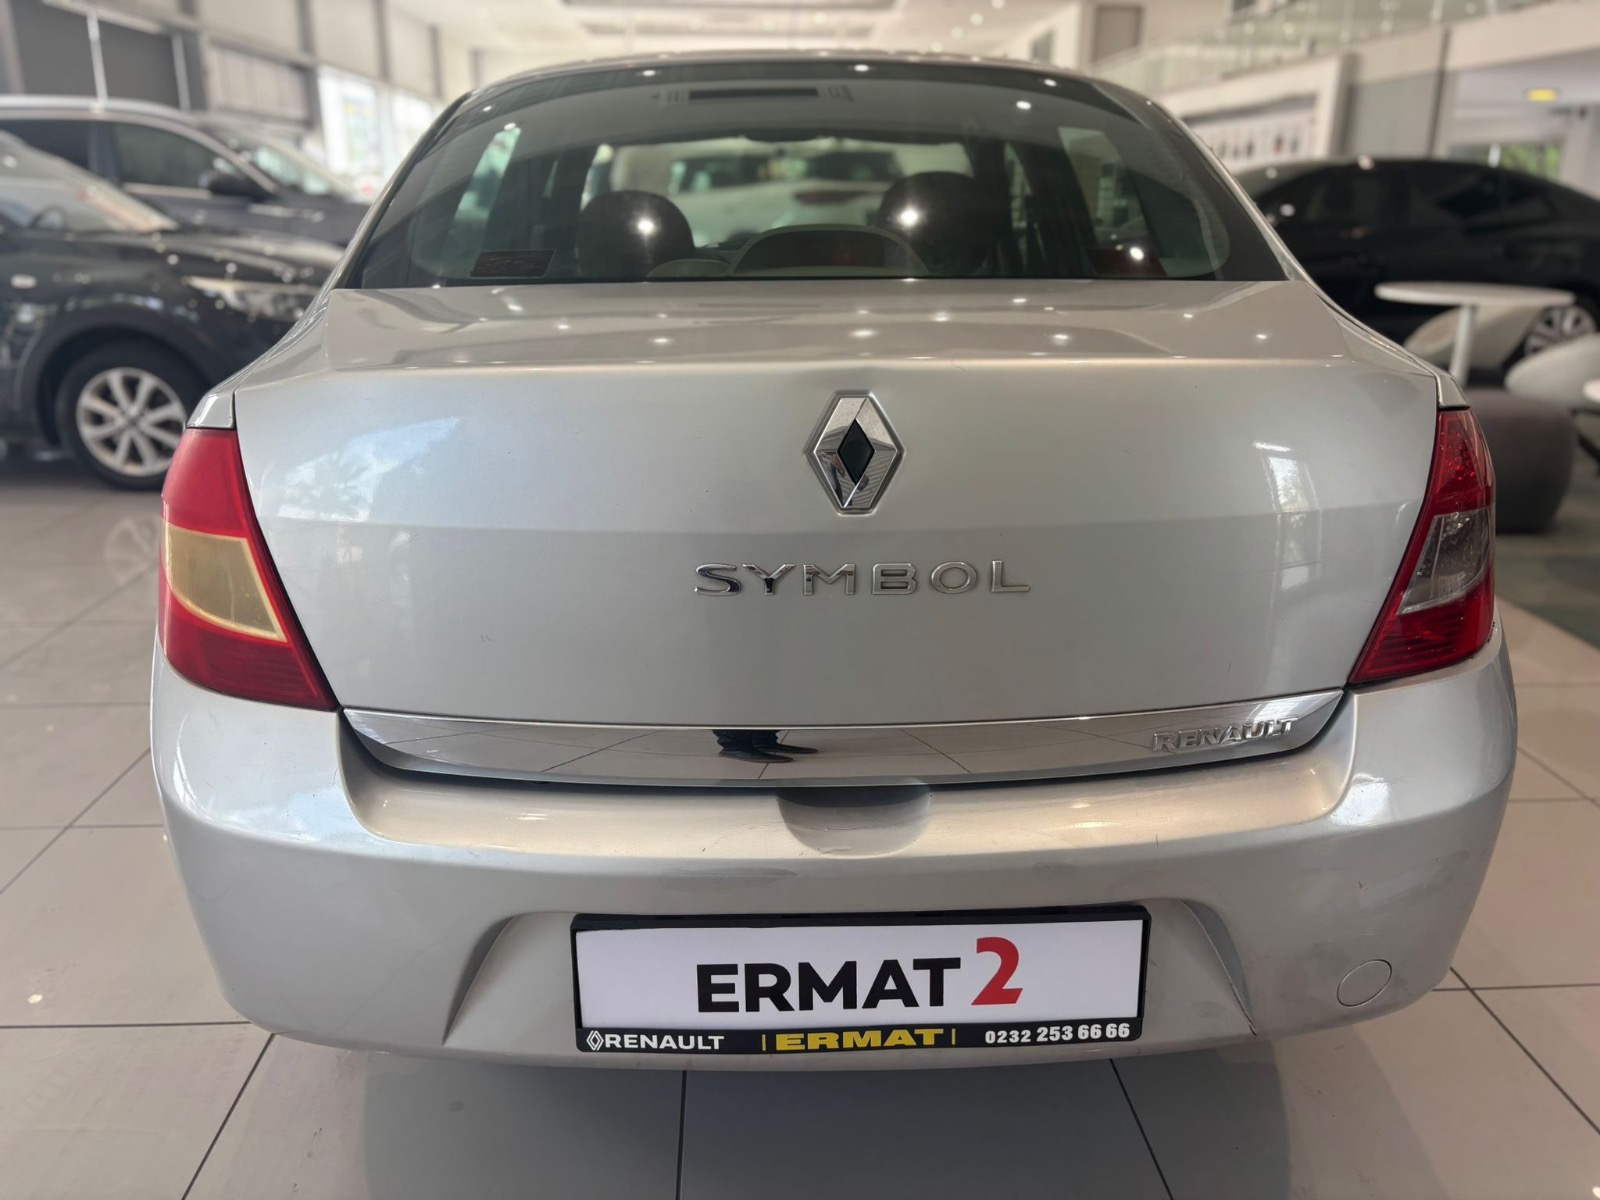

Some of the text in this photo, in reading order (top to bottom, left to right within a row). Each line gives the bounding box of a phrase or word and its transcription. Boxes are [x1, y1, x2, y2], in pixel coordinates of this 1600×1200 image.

[694, 560, 1031, 597] SYMBOL
[1152, 717, 1298, 751] RENAULT
[697, 936, 1024, 1013] ERMAT 2
[605, 1033, 725, 1050] RENAULT
[775, 1028, 945, 1051] ERMAT
[984, 1022, 1131, 1044] 0232 253 66 66
